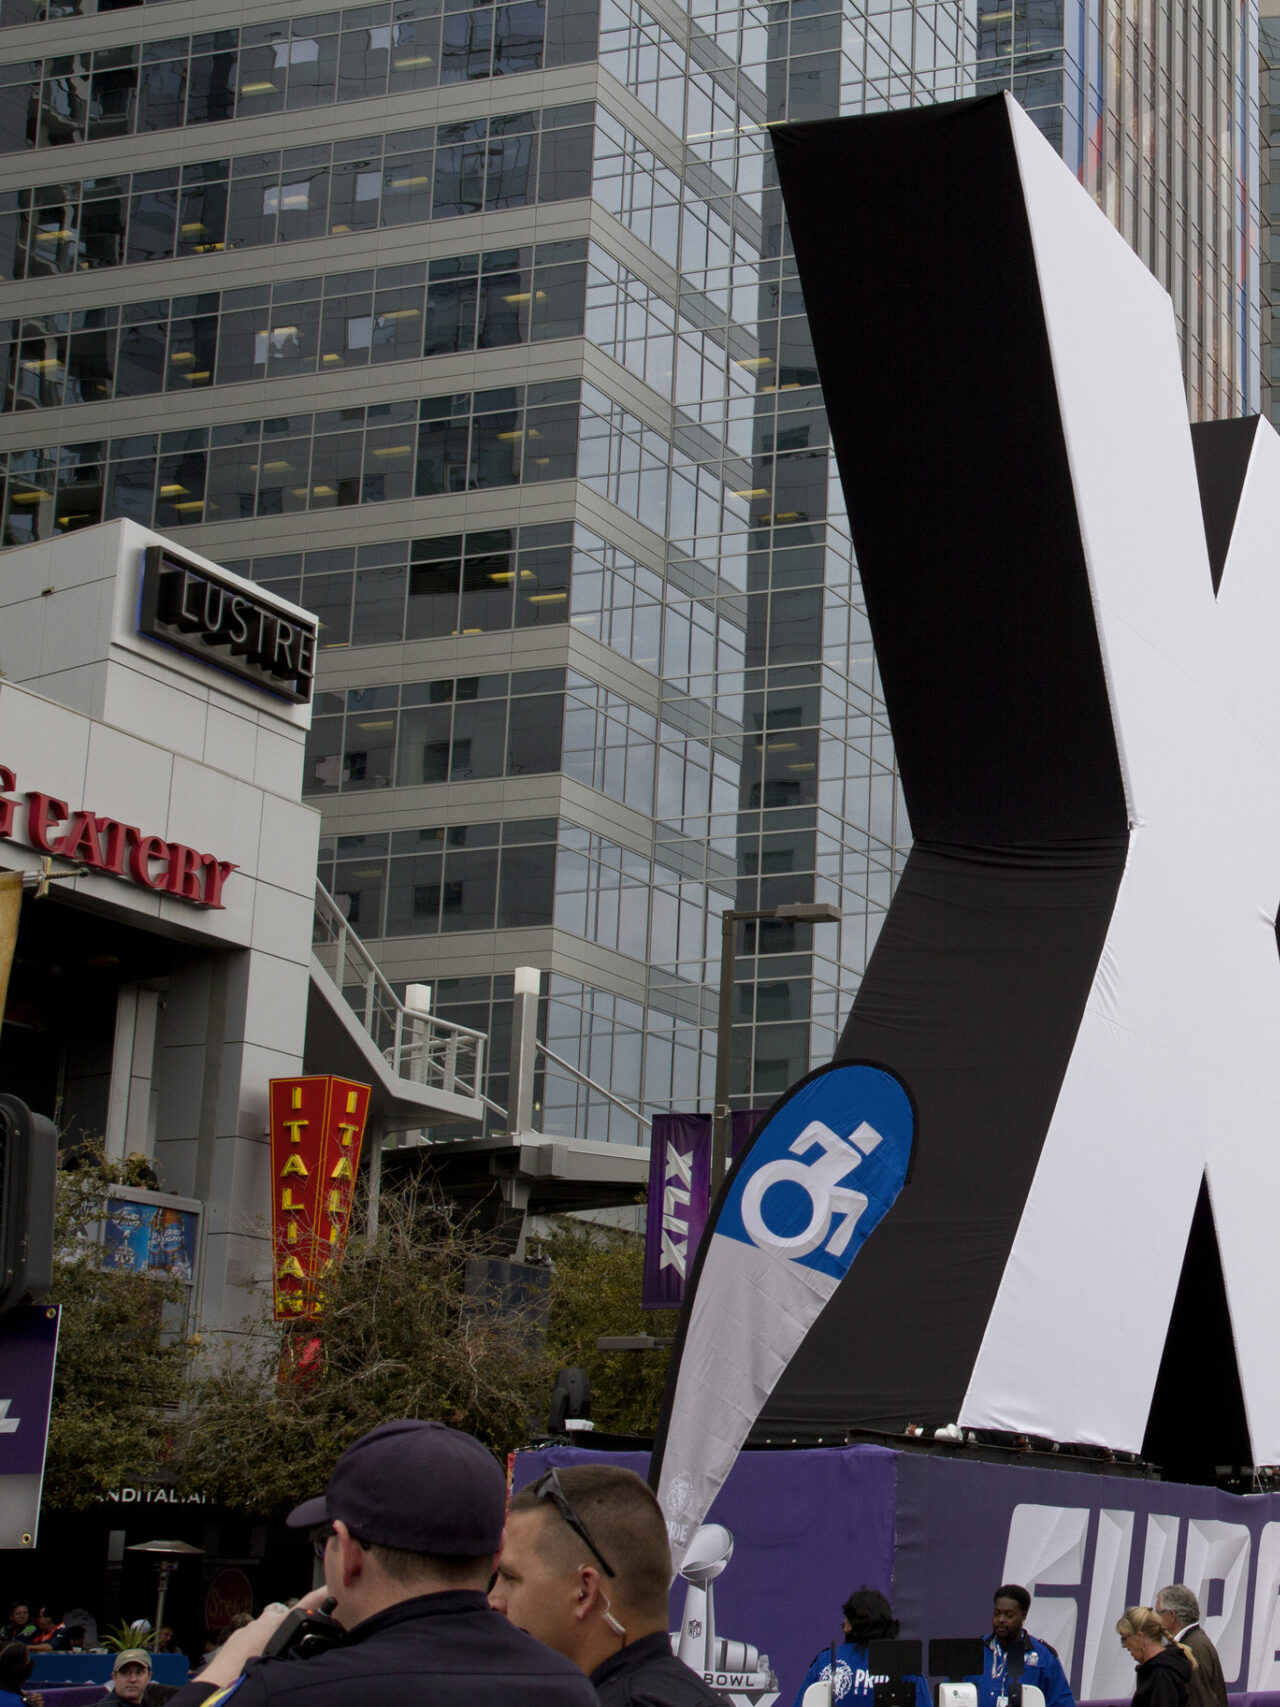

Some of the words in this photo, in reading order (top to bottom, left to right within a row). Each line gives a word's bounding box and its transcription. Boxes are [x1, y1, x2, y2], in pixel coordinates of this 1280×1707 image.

[176, 567, 316, 680] LUSTRE
[660, 1141, 694, 1281] XLIX
[703, 1673, 755, 1688] BOWL
